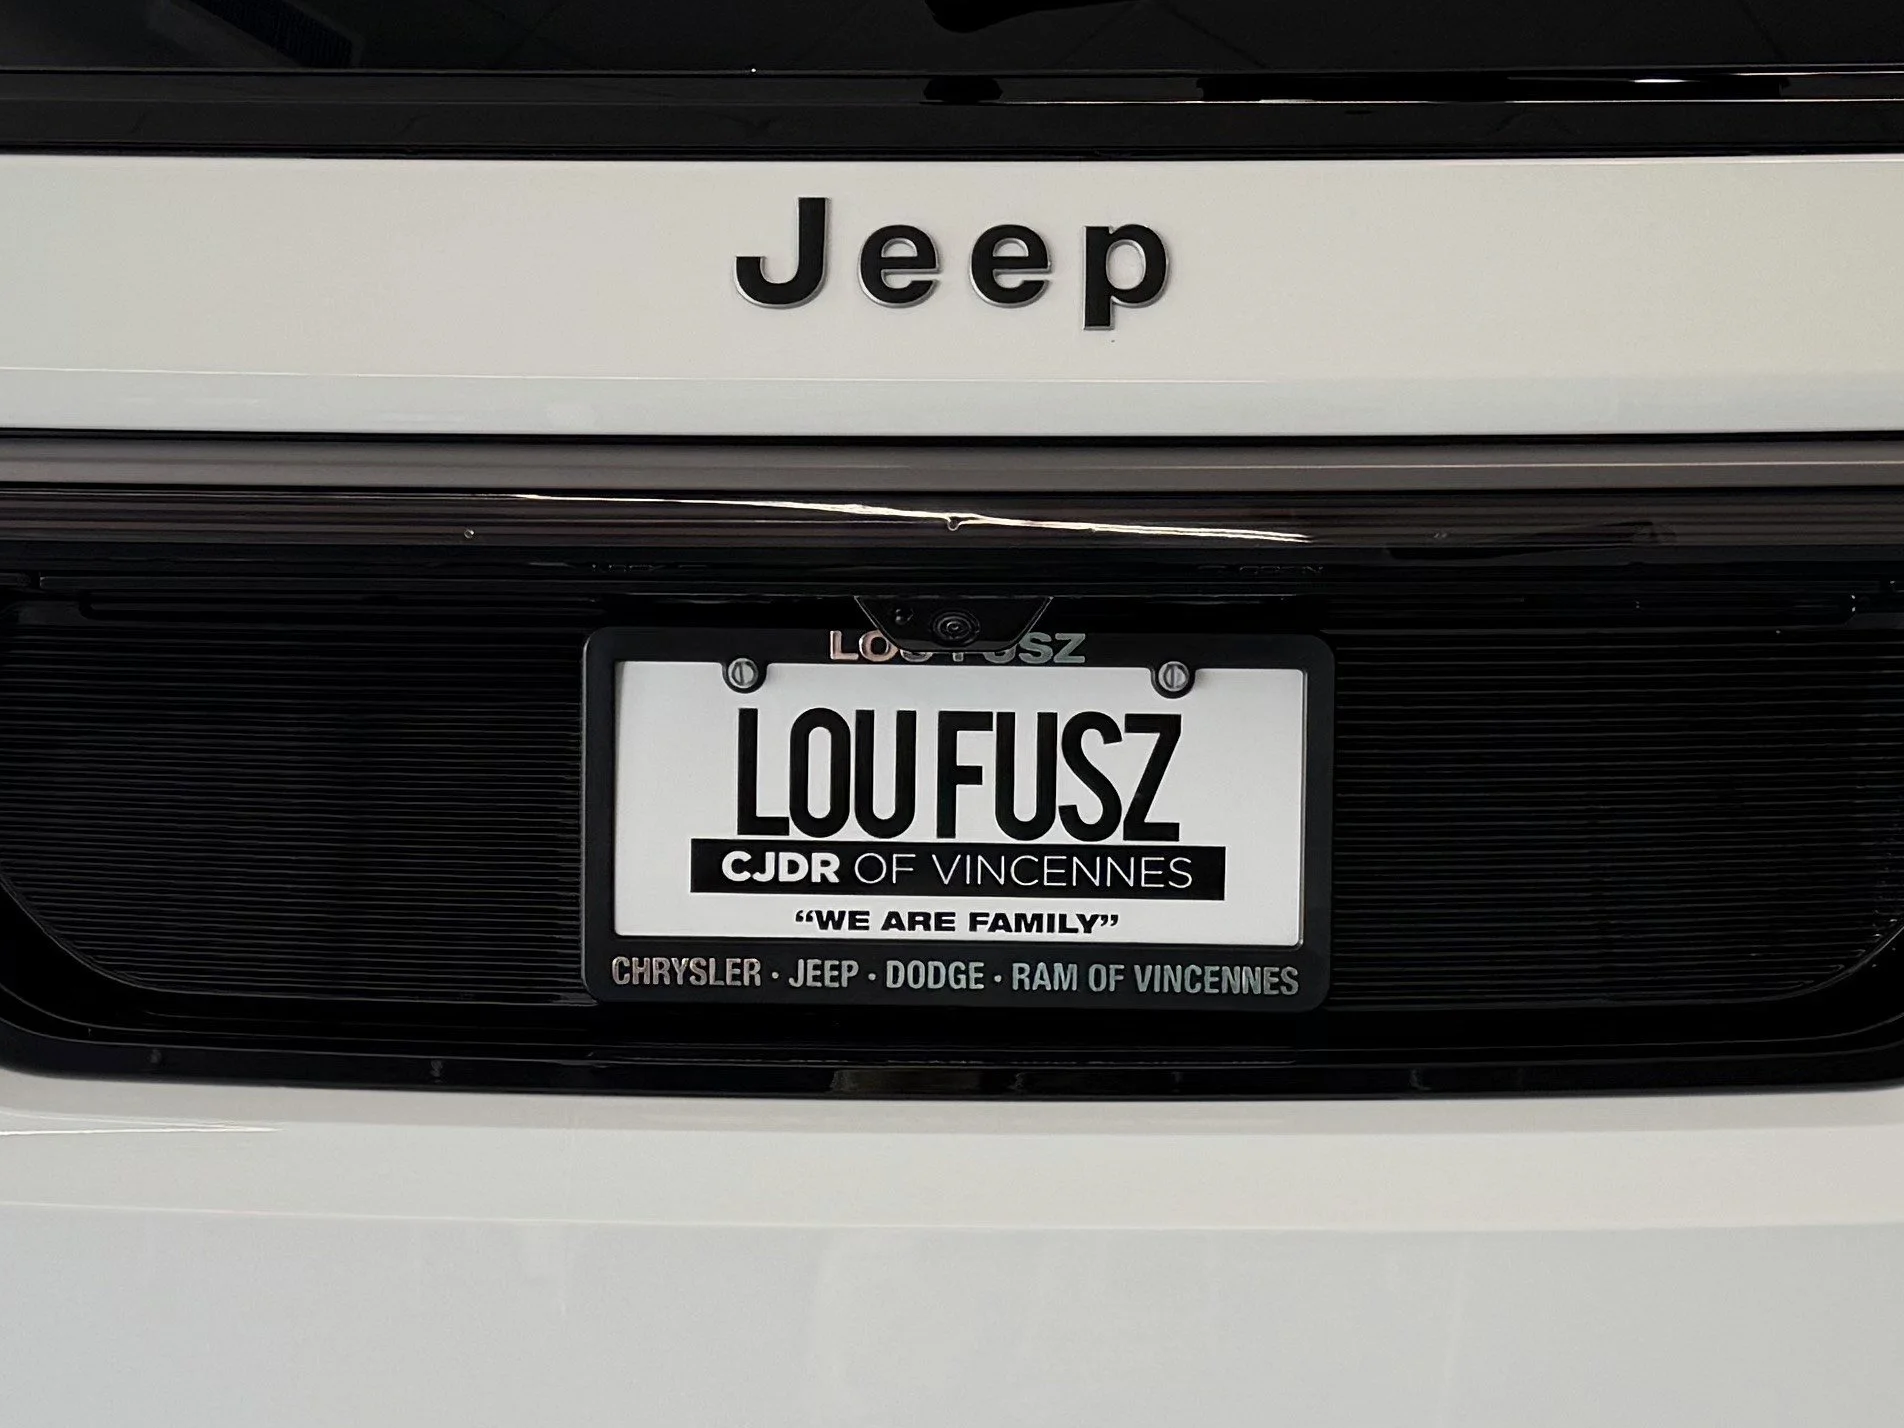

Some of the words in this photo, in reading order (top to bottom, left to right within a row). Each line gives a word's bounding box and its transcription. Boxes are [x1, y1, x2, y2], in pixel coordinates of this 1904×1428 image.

[734, 196, 1170, 331] Jeep
[737, 707, 919, 840] LOU
[936, 709, 1183, 843] FUSZ
[721, 849, 841, 884] CJDR
[854, 850, 915, 887] OF
[936, 853, 1193, 891] VINCENNES
[880, 910, 957, 934] ARE
[611, 955, 762, 987] CHRYSLER
[788, 958, 860, 988] JEEP
[885, 959, 985, 990] DODGE
[1011, 961, 1078, 991] RAM
[1088, 963, 1125, 992] OF
[1133, 964, 1299, 996] VINCENNES
